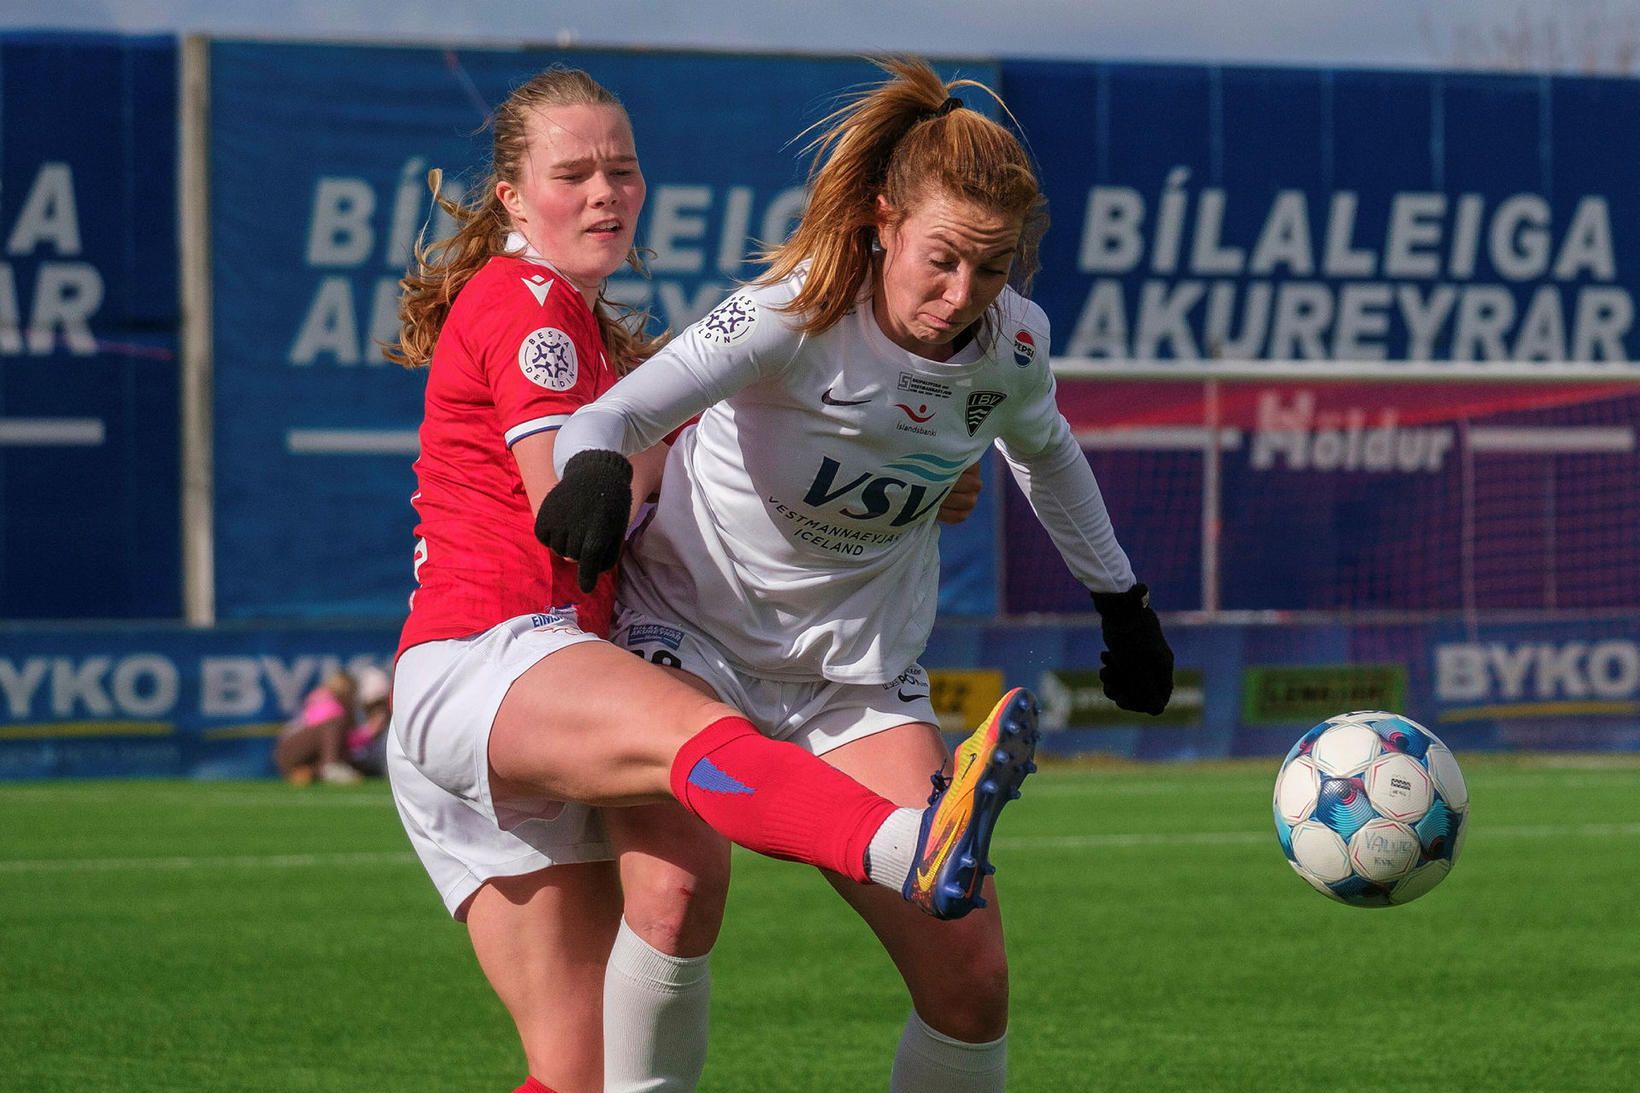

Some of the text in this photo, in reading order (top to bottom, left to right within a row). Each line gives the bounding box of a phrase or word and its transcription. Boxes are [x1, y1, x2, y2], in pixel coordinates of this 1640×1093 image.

[1078, 166, 1616, 281] BÍLALEIGA
[528, 330, 570, 347] BESTA
[1064, 280, 1637, 362] AKUREYRAR
[1014, 340, 1035, 358] PEPSI
[525, 366, 575, 388] DEILDIN
[803, 456, 950, 527] VSV
[768, 496, 902, 544] VESTMANNAEYJA
[794, 529, 864, 556] ICELAND
[0, 652, 182, 719] YKO
[1435, 638, 1640, 700] BYKO
